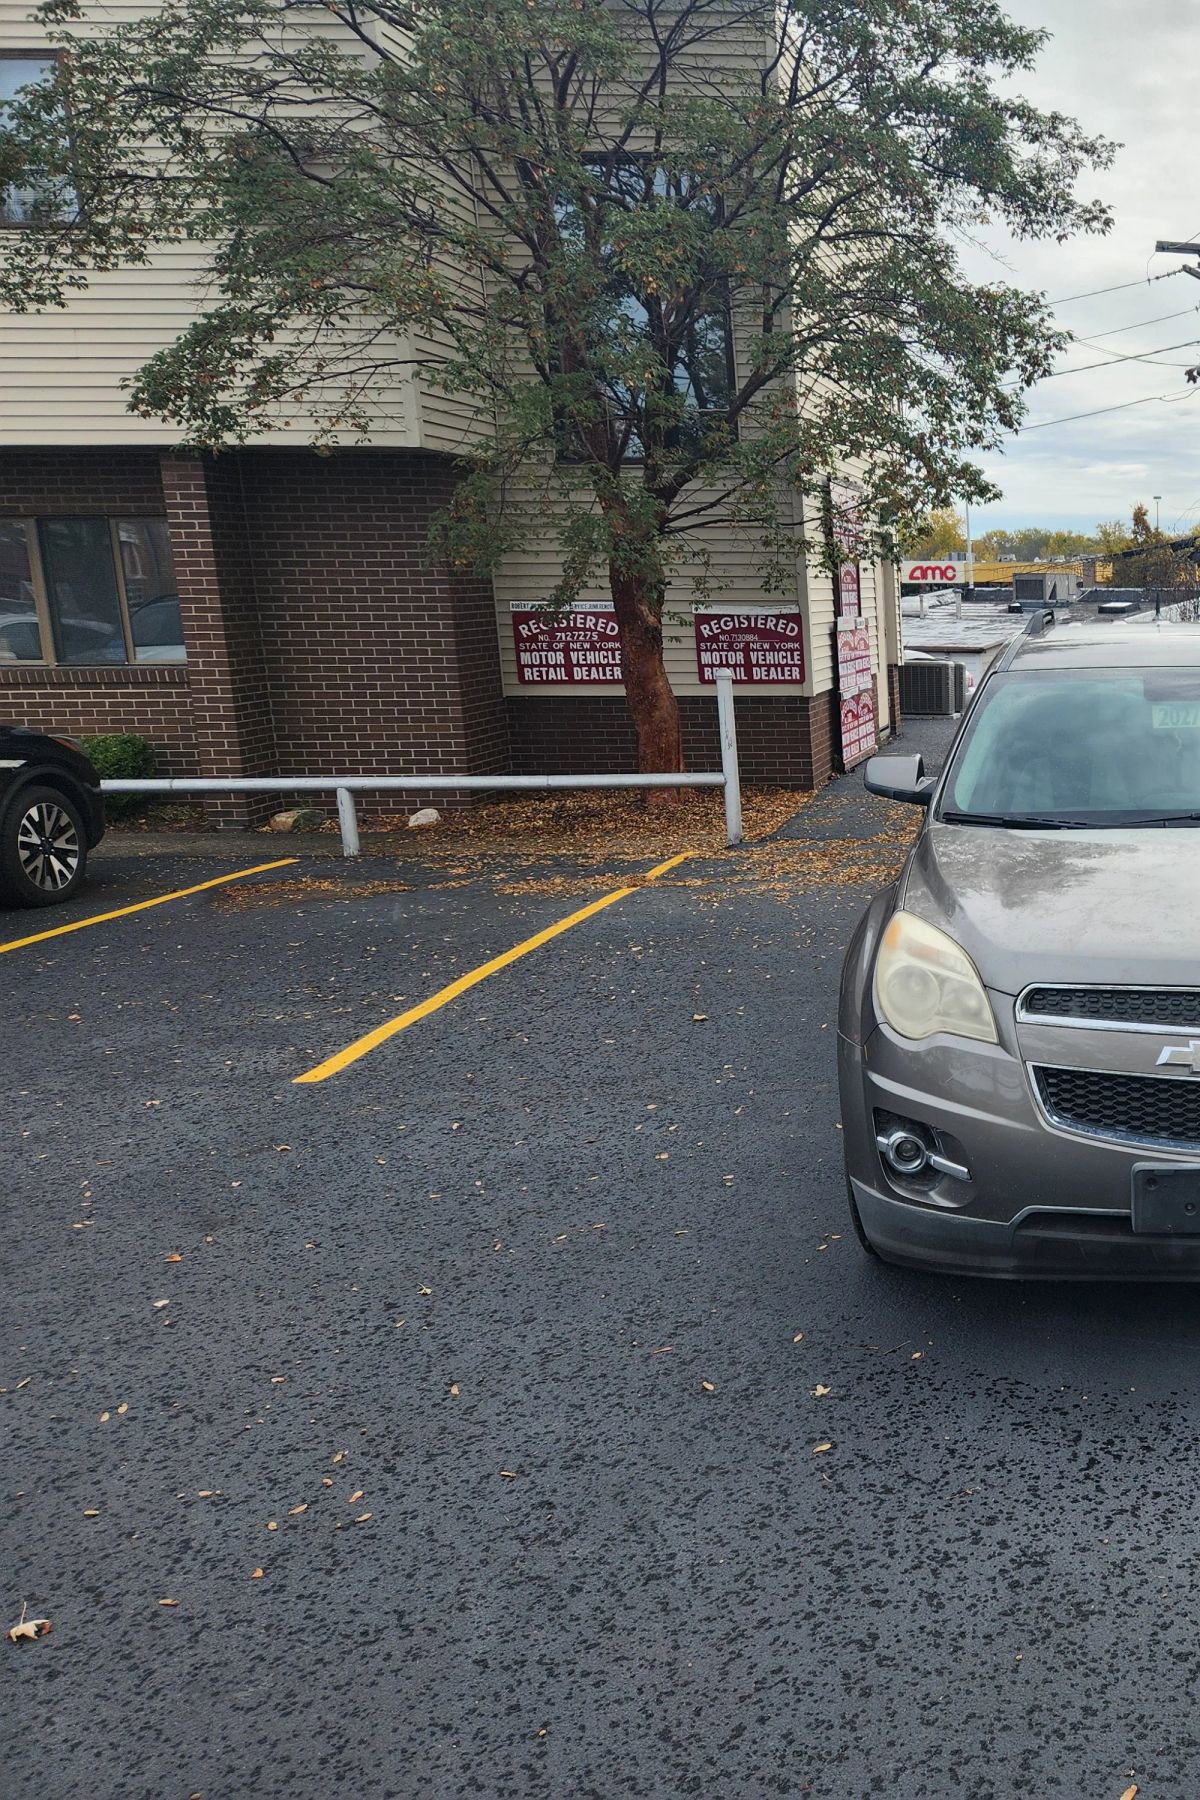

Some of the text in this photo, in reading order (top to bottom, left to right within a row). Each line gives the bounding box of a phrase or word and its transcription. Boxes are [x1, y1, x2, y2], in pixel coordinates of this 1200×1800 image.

[699, 615, 799, 638] REGISTERED
[555, 631, 599, 640] 7127275
[519, 642, 549, 650] STATE
[552, 642, 566, 650] OF
[594, 641, 621, 649] YORK
[699, 642, 800, 650] STATE OF NEW YORK
[520, 650, 621, 665] MOTOR VEHICLE
[700, 651, 801, 665] MOTOR VEHICLE
[523, 666, 622, 681] RETAIL DEALER
[703, 667, 800, 680] REAIL DEALER
[1157, 707, 1200, 727] 2027
